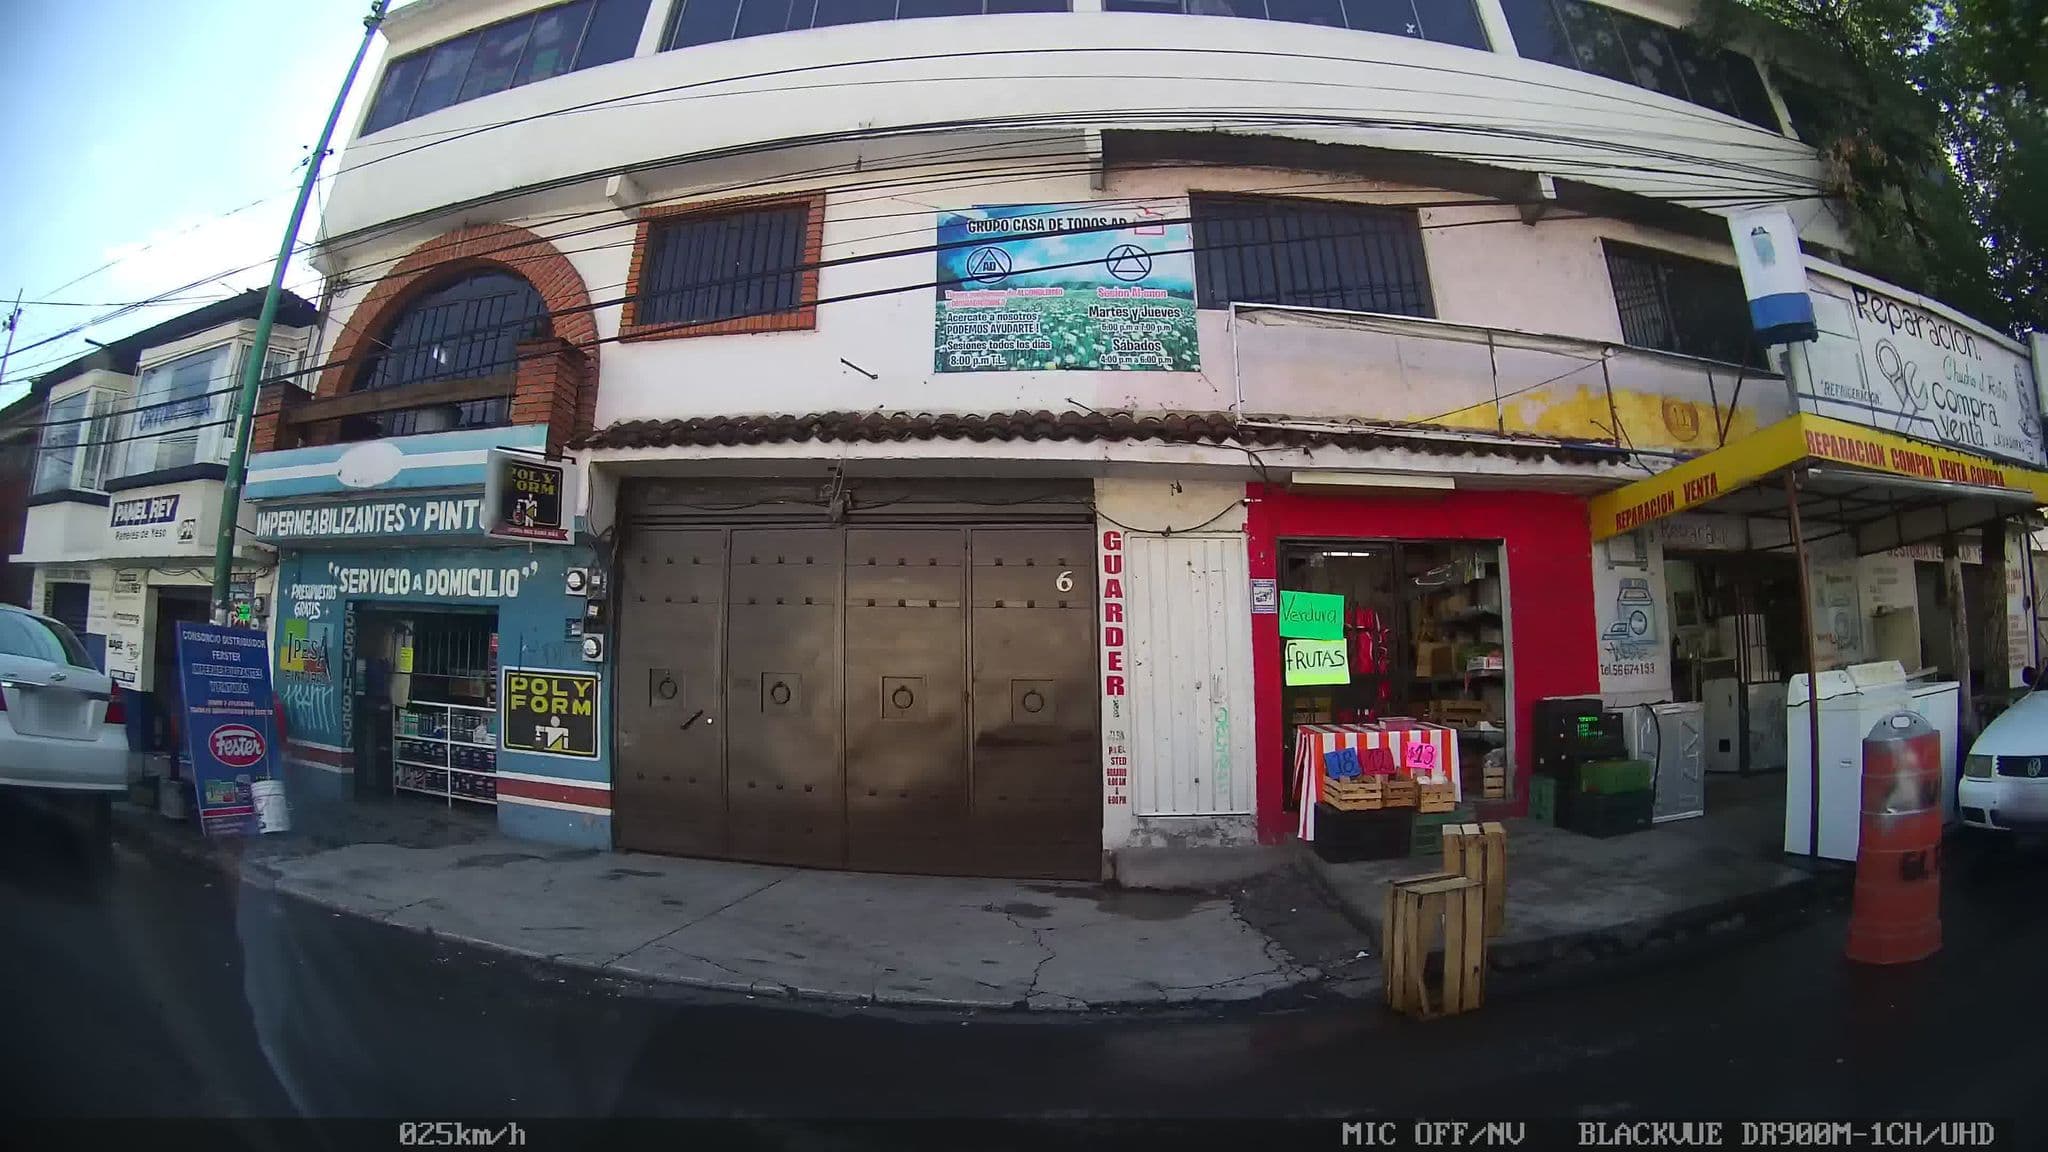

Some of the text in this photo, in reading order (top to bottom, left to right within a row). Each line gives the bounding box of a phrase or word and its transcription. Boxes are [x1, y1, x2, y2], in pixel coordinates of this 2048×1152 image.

[968, 218, 1011, 233] GRUPO
[1013, 217, 1046, 232] CASA
[1048, 217, 1065, 231] DE
[1067, 216, 1109, 230] TODOS
[983, 261, 997, 272] AD
[1089, 305, 1181, 321] Martes y Jueves
[947, 324, 989, 334] PODEMOS
[990, 323, 1034, 334] AYUDARTE
[947, 340, 987, 351] Sesiones
[989, 340, 1015, 350] todos
[1016, 340, 1030, 350] los
[1113, 338, 1161, 352] Sábados
[950, 355, 971, 366] 8:00
[1101, 355, 1118, 364] 4:00
[1805, 429, 1886, 467] REPARACION
[1891, 448, 1936, 478] COMPRA
[1615, 472, 1717, 530] REPARACION VENTA
[114, 497, 176, 526] PANEL REY
[256, 503, 405, 538] IMPERMEABILIZANTES
[409, 507, 418, 527] Y
[413, 574, 423, 592] A
[1055, 570, 1074, 592] 6
[291, 584, 338, 600] PRESUPUESTOS
[294, 601, 321, 620] GRATIS
[1280, 593, 1337, 623] Verdura
[182, 630, 221, 645] CONSORCIO
[1285, 642, 1346, 672] FRUTAS
[510, 676, 591, 698] POLY
[511, 694, 592, 716] FORM
[215, 729, 262, 757] Fester
